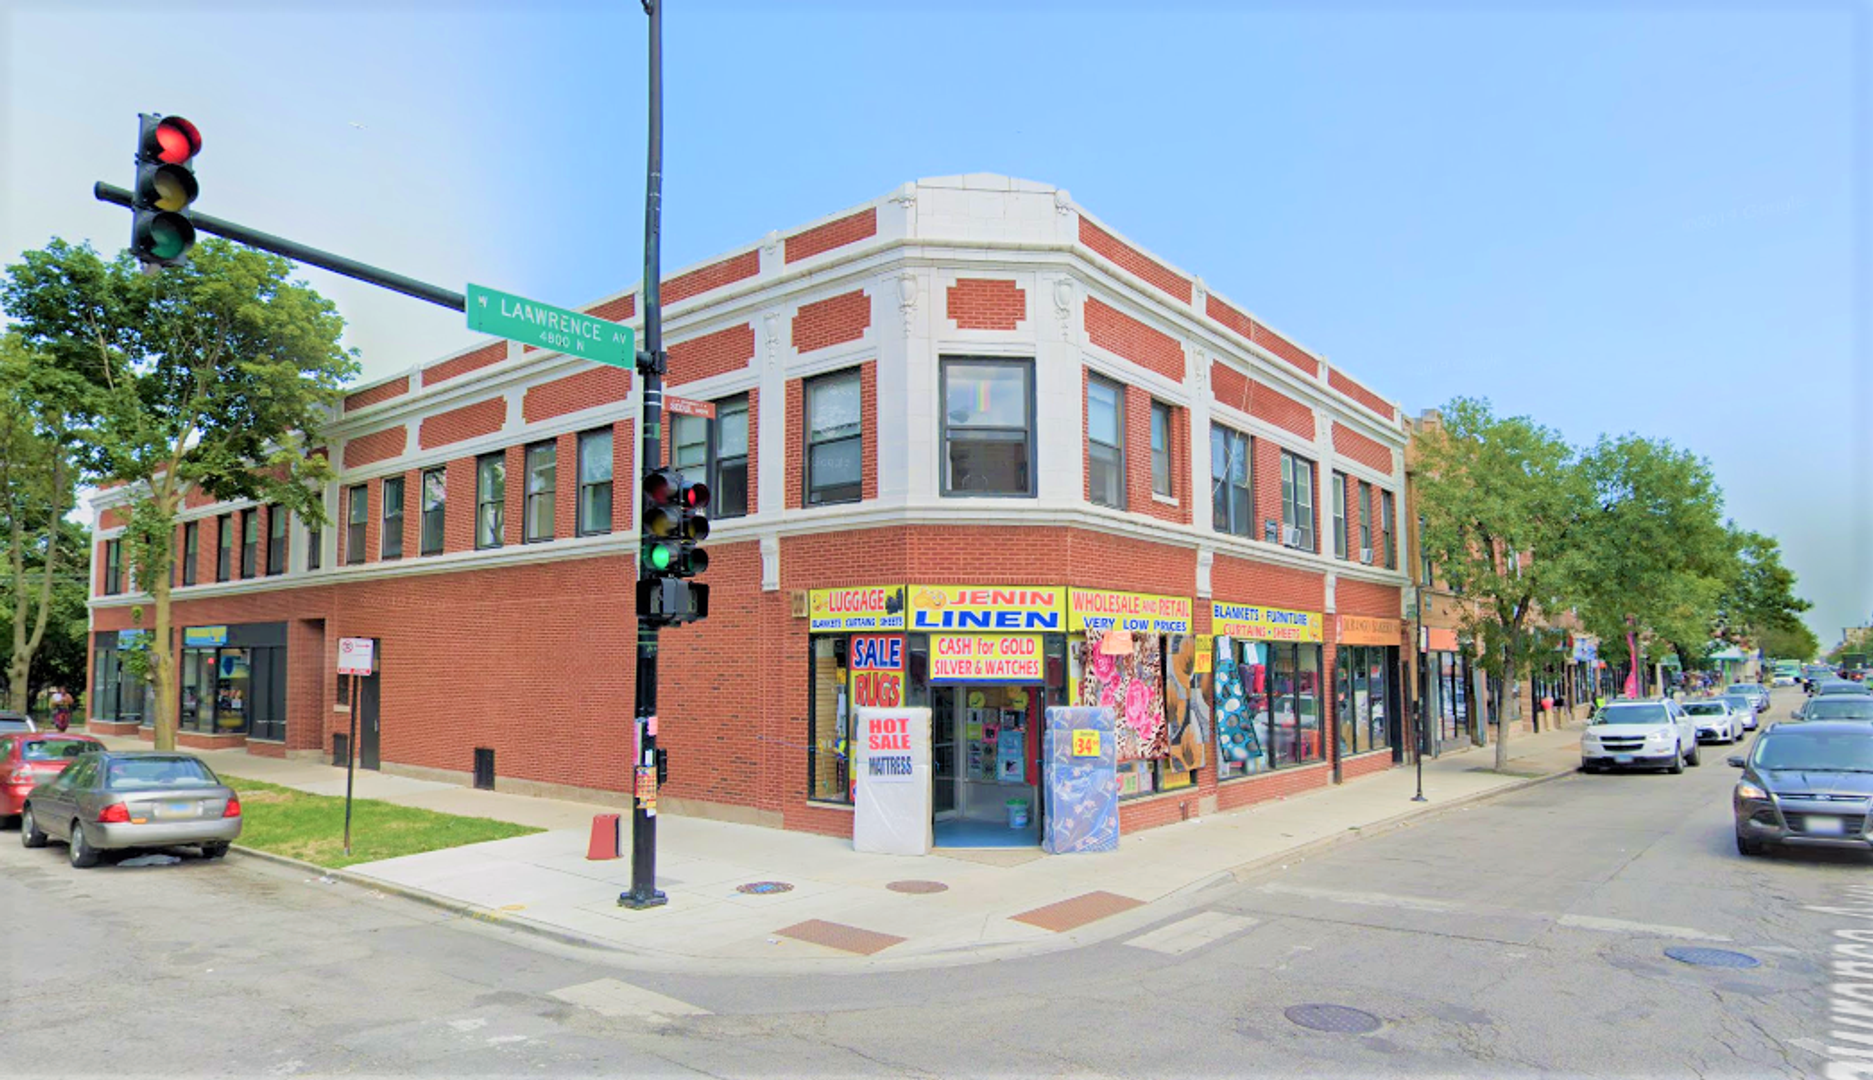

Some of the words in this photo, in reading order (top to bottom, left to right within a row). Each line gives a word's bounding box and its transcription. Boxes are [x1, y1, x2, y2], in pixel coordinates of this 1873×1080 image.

[539, 331, 570, 348] 4800
[576, 339, 585, 351] N
[612, 332, 627, 344] AV
[829, 589, 884, 612] LUGGAGE
[950, 590, 1054, 606] JENIN
[1072, 591, 1140, 614] WHOLESALE
[1142, 600, 1157, 613] AND
[1159, 598, 1190, 617] RETAIL
[915, 611, 1058, 628] LINEN
[1214, 604, 1259, 621] BLANKETS
[1266, 610, 1307, 626] FURNITURE
[1083, 616, 1116, 628] VERY
[1123, 619, 1149, 630] LOW
[1153, 620, 1187, 632] PRICES
[1223, 623, 1266, 637] CURTAINS
[1273, 627, 1300, 639] SHEETS
[854, 639, 900, 668] SALE
[938, 638, 972, 655] CASH
[977, 638, 994, 655] for
[1000, 638, 1035, 655] GOLD
[934, 660, 972, 675] SILVER
[975, 660, 982, 675] &
[985, 660, 1039, 675] WATCHES
[855, 672, 900, 707] RUGS
[869, 718, 910, 734] HOT
[868, 735, 911, 750] SALE
[868, 756, 913, 776] MATTRESS
